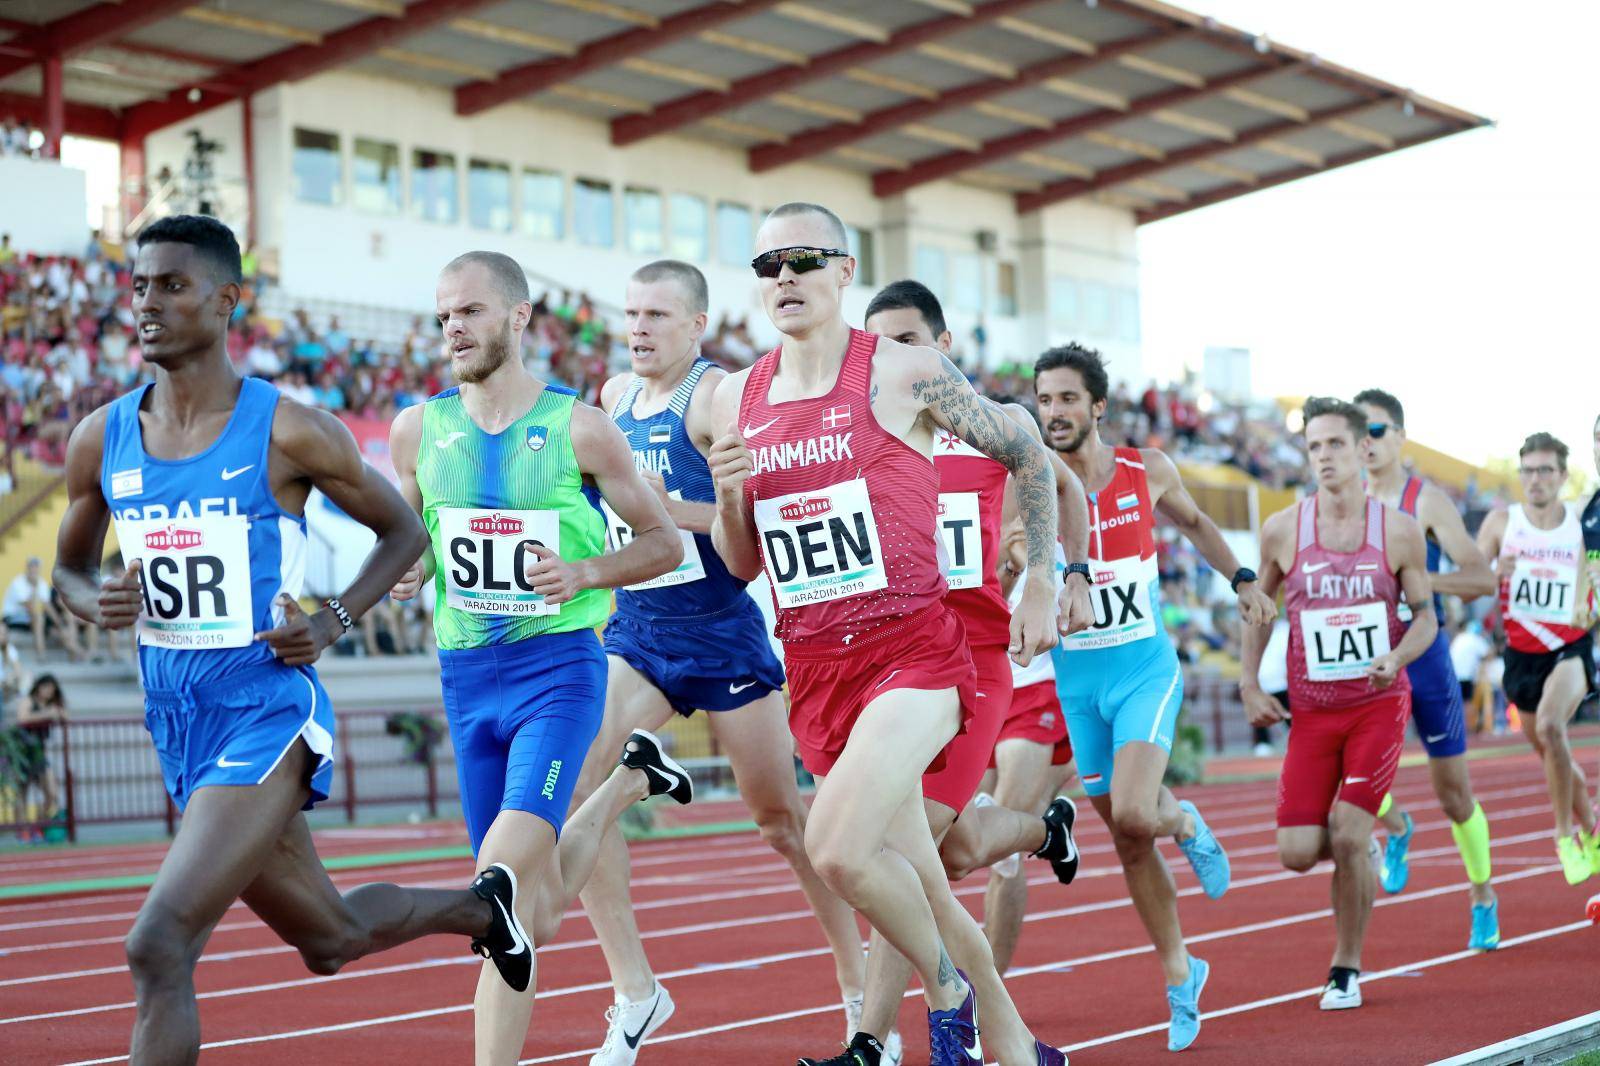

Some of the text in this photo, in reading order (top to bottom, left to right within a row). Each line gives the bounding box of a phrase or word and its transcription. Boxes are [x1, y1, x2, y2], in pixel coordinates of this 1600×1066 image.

[751, 432, 854, 476] DANMARK
[783, 503, 829, 517] PODRAVKA
[473, 521, 520, 531] PODRAVKA
[1089, 511, 1141, 532] BOURG
[147, 533, 200, 546] PODRAVKA
[764, 512, 874, 583] DEN
[1520, 549, 1574, 560] AUSTRIA
[667, 573, 685, 584] 2019
[1306, 574, 1375, 600] LATVIA
[789, 581, 865, 604] VARAŽDIN 2019
[1515, 578, 1570, 610] AUT
[463, 600, 537, 612] VARAŽDIN 2019
[1088, 581, 1144, 629] UX
[196, 633, 224, 645] 2019
[1315, 625, 1378, 664] LAT
